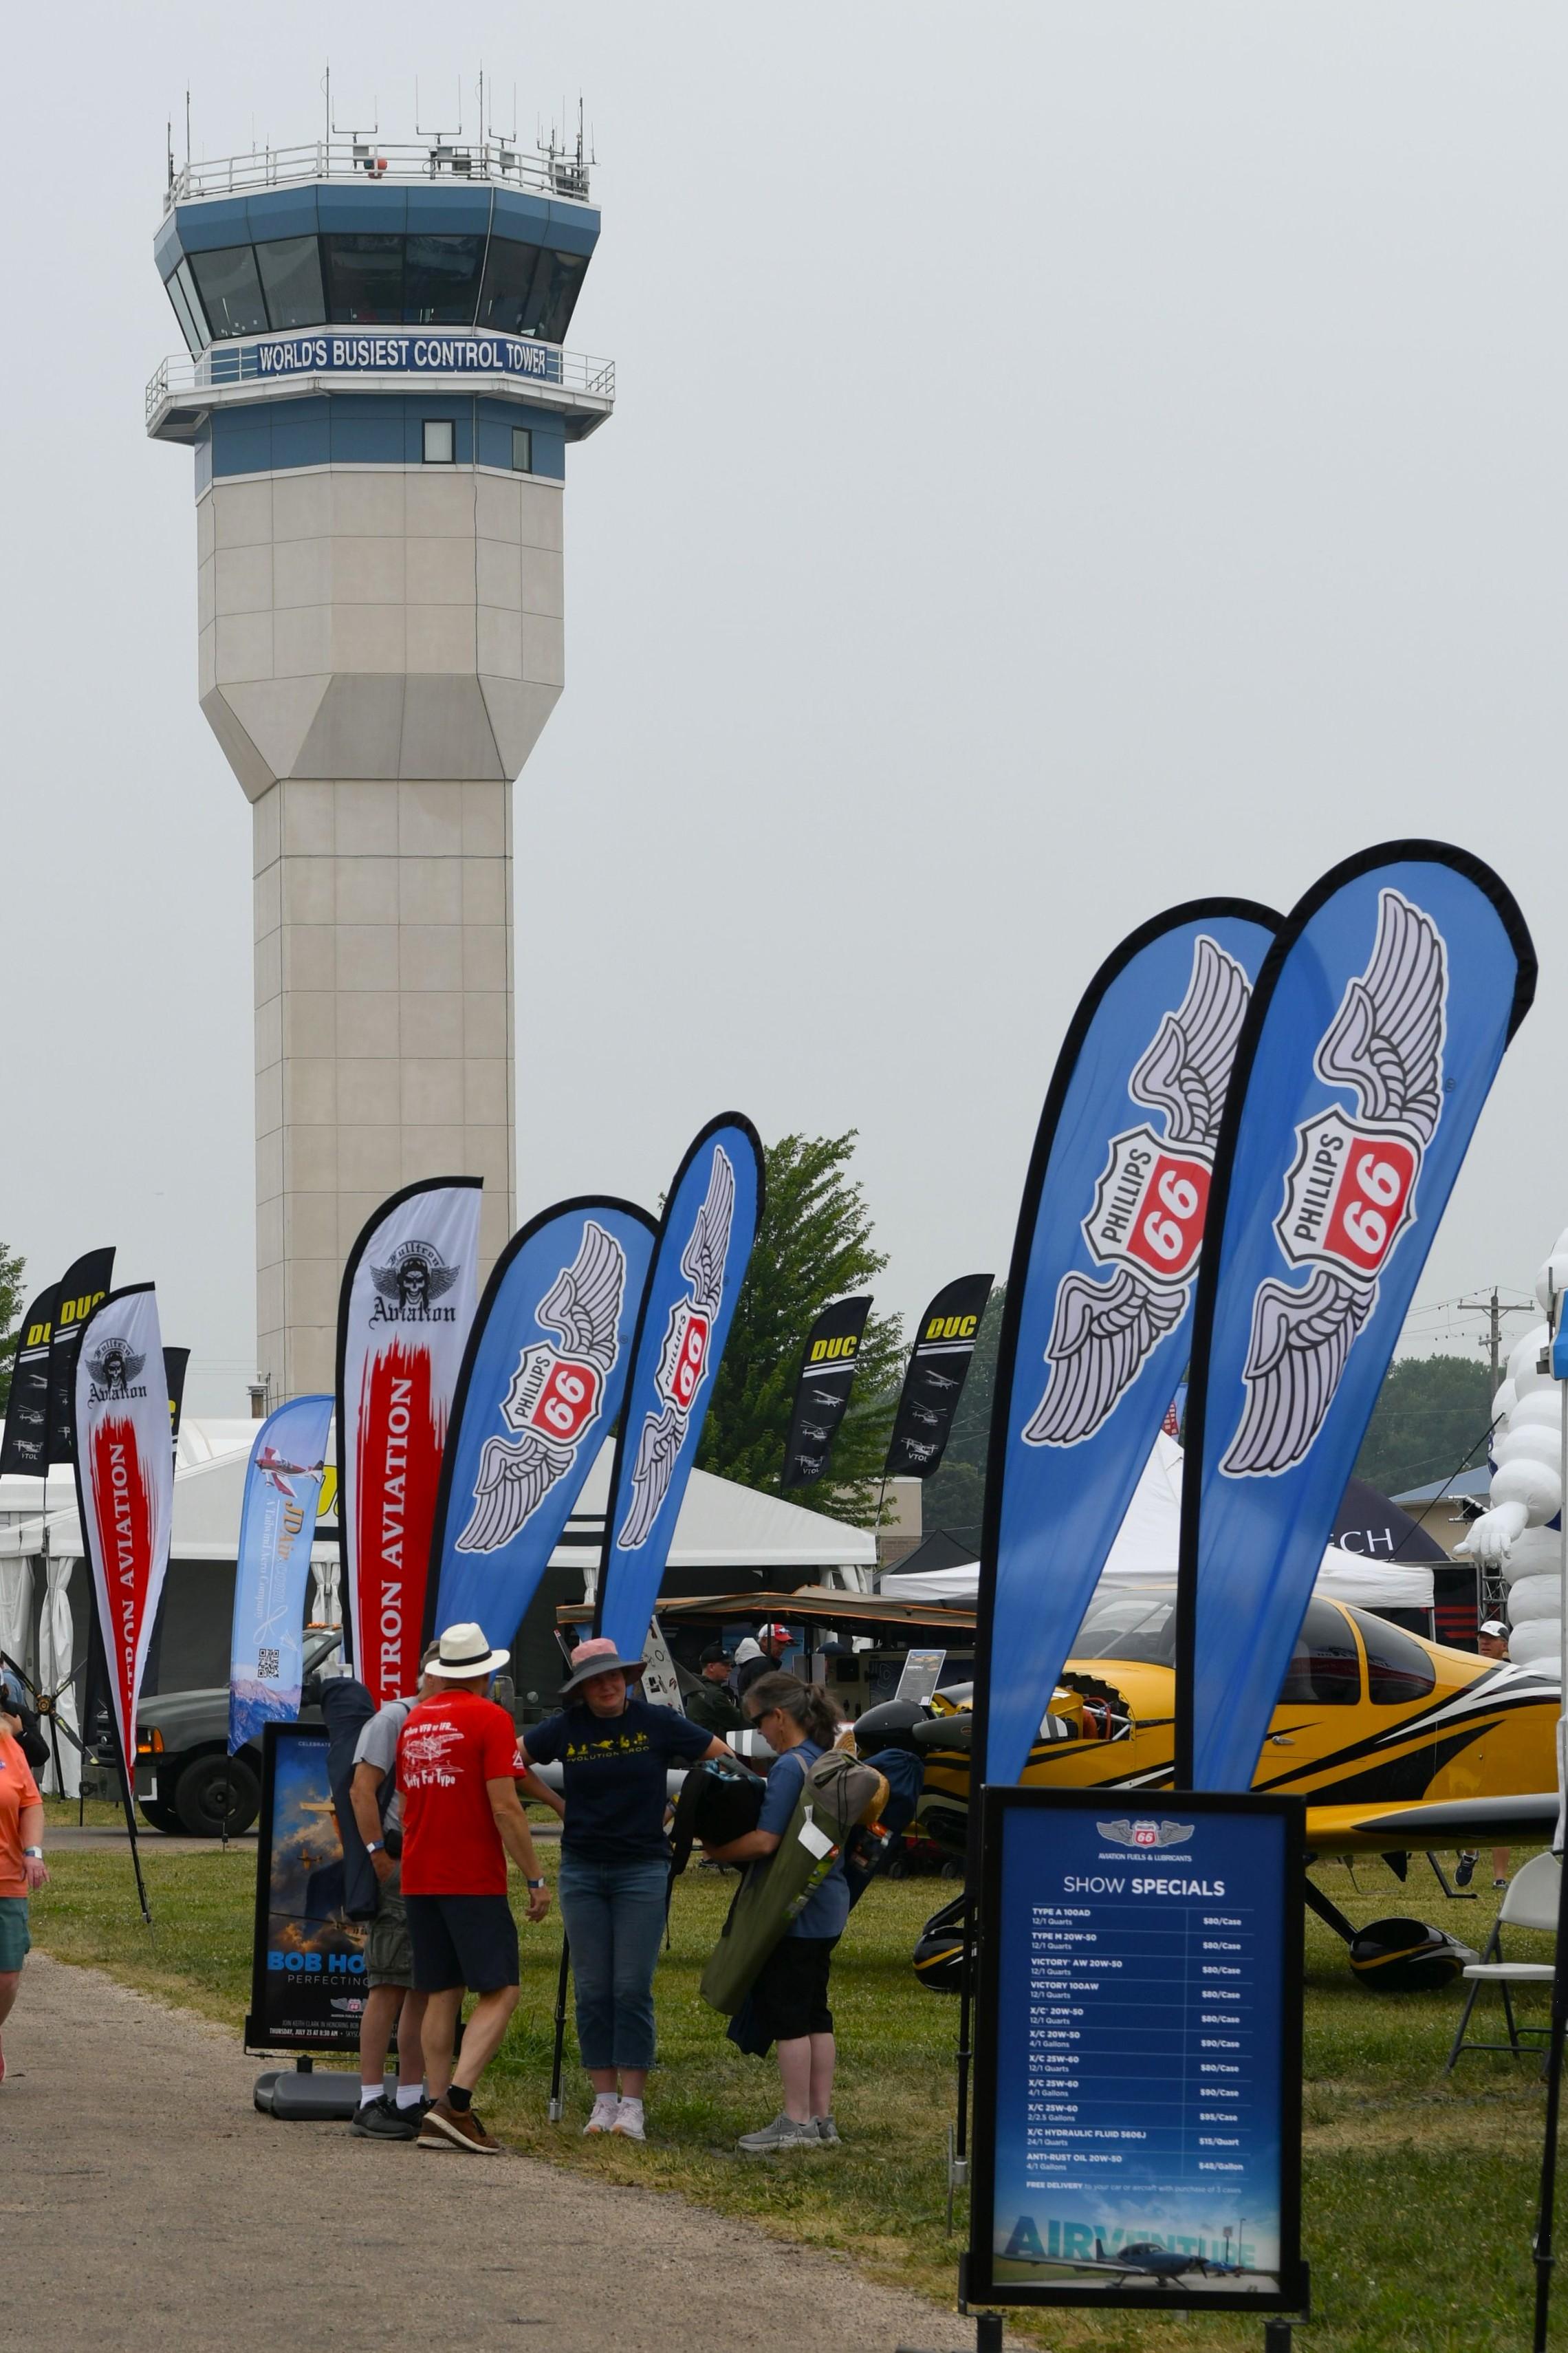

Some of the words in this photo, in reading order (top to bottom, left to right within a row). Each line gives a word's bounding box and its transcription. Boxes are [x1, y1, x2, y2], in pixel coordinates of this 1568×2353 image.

[259, 340, 327, 371] WORLD'S
[333, 340, 409, 366] BUSIEST
[414, 340, 503, 367] CONTROL
[506, 343, 545, 375] TOWER
[1294, 1134, 1344, 1242] PHILLIPS
[1101, 1149, 1152, 1244] PHILLIPS
[1343, 1153, 1400, 1254] 66
[1143, 1171, 1198, 1260] 66
[369, 1295, 456, 1330] Aviation
[925, 1315, 977, 1339] DUC
[810, 1335, 858, 1361] DUC
[680, 1327, 703, 1396] 66
[514, 1355, 551, 1419] PHILLIPS
[87, 1382, 147, 1409] Aviation
[544, 1370, 586, 1431] 66
[908, 1452, 928, 1462] VTOL
[382, 1376, 413, 1570] AVIATION
[803, 1467, 820, 1475] VTOL
[109, 1444, 134, 1589] AVIATION
[436, 1768, 455, 1787] Type
[1137, 1832, 1153, 1843] 66
[1154, 1854, 1193, 1863] LUBRICANTS
[1063, 1876, 1126, 1894] SHOW
[1131, 1878, 1226, 1897] SPECIALS
[1032, 1907, 1054, 1916] TYPE
[1064, 1909, 1091, 1917] 100AD
[1032, 1918, 1047, 1926] 12/1
[1048, 1918, 1072, 1927] Quarts
[1204, 1917, 1242, 1926] $80/Case
[1032, 1932, 1054, 1940] TYPE
[1063, 1933, 1097, 1942] 20W-50
[1032, 1942, 1046, 1950] 12/1
[1047, 1942, 1071, 1951] Quarts
[1203, 1942, 1241, 1951] $80/Case
[268, 1951, 322, 1971] BOB
[1089, 1960, 1122, 1968] 20W-50
[1202, 1966, 1241, 1975] $80/Case
[1031, 1981, 1067, 1989] VICTORY
[1030, 1991, 1045, 1999] 12/1
[1047, 1991, 1071, 1999] Quarts
[1201, 1991, 1241, 1999] $80/Case
[1050, 2007, 1084, 2016] 20W-50
[1030, 2017, 1045, 2025] 12/1
[1046, 2017, 1070, 2025] Quarts
[1201, 2015, 1240, 2024] $80/Case
[1030, 2030, 1045, 2039] X/C
[1047, 2030, 1080, 2039] 20W-50
[1043, 2040, 1070, 2048] Gallons
[1201, 2039, 1240, 2048] $90/Case
[1029, 2054, 1045, 2063] X/C
[1047, 2055, 1080, 2063] 25W-60
[1029, 2064, 1043, 2072] 12/1
[1045, 2065, 1069, 2073] Quarts
[1200, 2064, 1239, 2072] $80/Case
[1028, 2079, 1045, 2088] X/C
[1046, 2079, 1079, 2088] 25W-60
[1041, 2089, 1069, 2098] Gallons
[1199, 2088, 1239, 2097] $90/Case
[1027, 2103, 1044, 2112] X/C
[1045, 2104, 1078, 2113] 25W-60
[1048, 2114, 1076, 2123] Gallons
[1027, 2128, 1043, 2136] X/C
[1045, 2129, 1093, 2138] HYDRAULIC
[1095, 2129, 1120, 2138] FLUID
[1044, 2138, 1068, 2147] Quarts
[1199, 2137, 1239, 2147] $15/Quart
[1027, 2153, 1071, 2162] ANTI-RUST
[1089, 2154, 1122, 2163] 20W-50
[1040, 2162, 1067, 2171] Gallons
